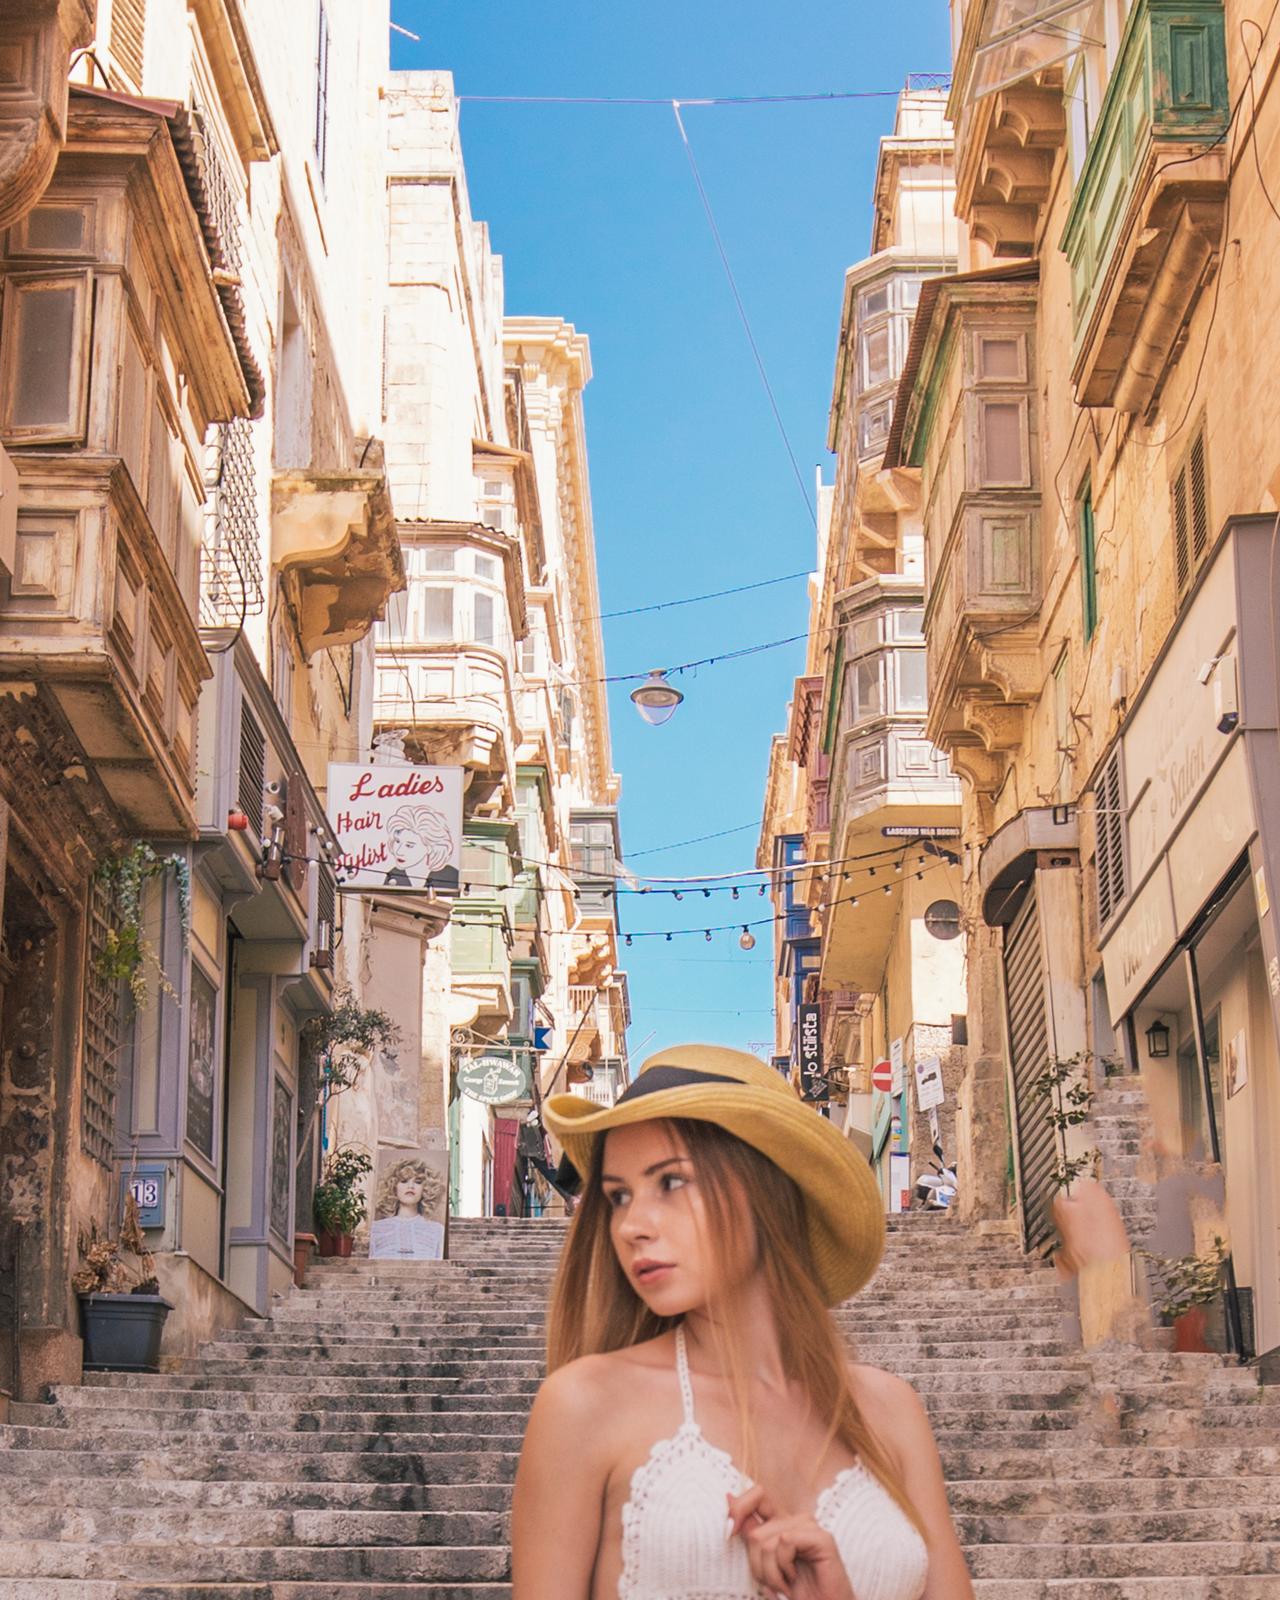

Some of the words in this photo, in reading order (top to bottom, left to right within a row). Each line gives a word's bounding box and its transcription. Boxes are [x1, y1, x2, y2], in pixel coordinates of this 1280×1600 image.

[349, 772, 444, 802] Ladies
[337, 810, 383, 834] Hair
[133, 1183, 157, 1203] 13
